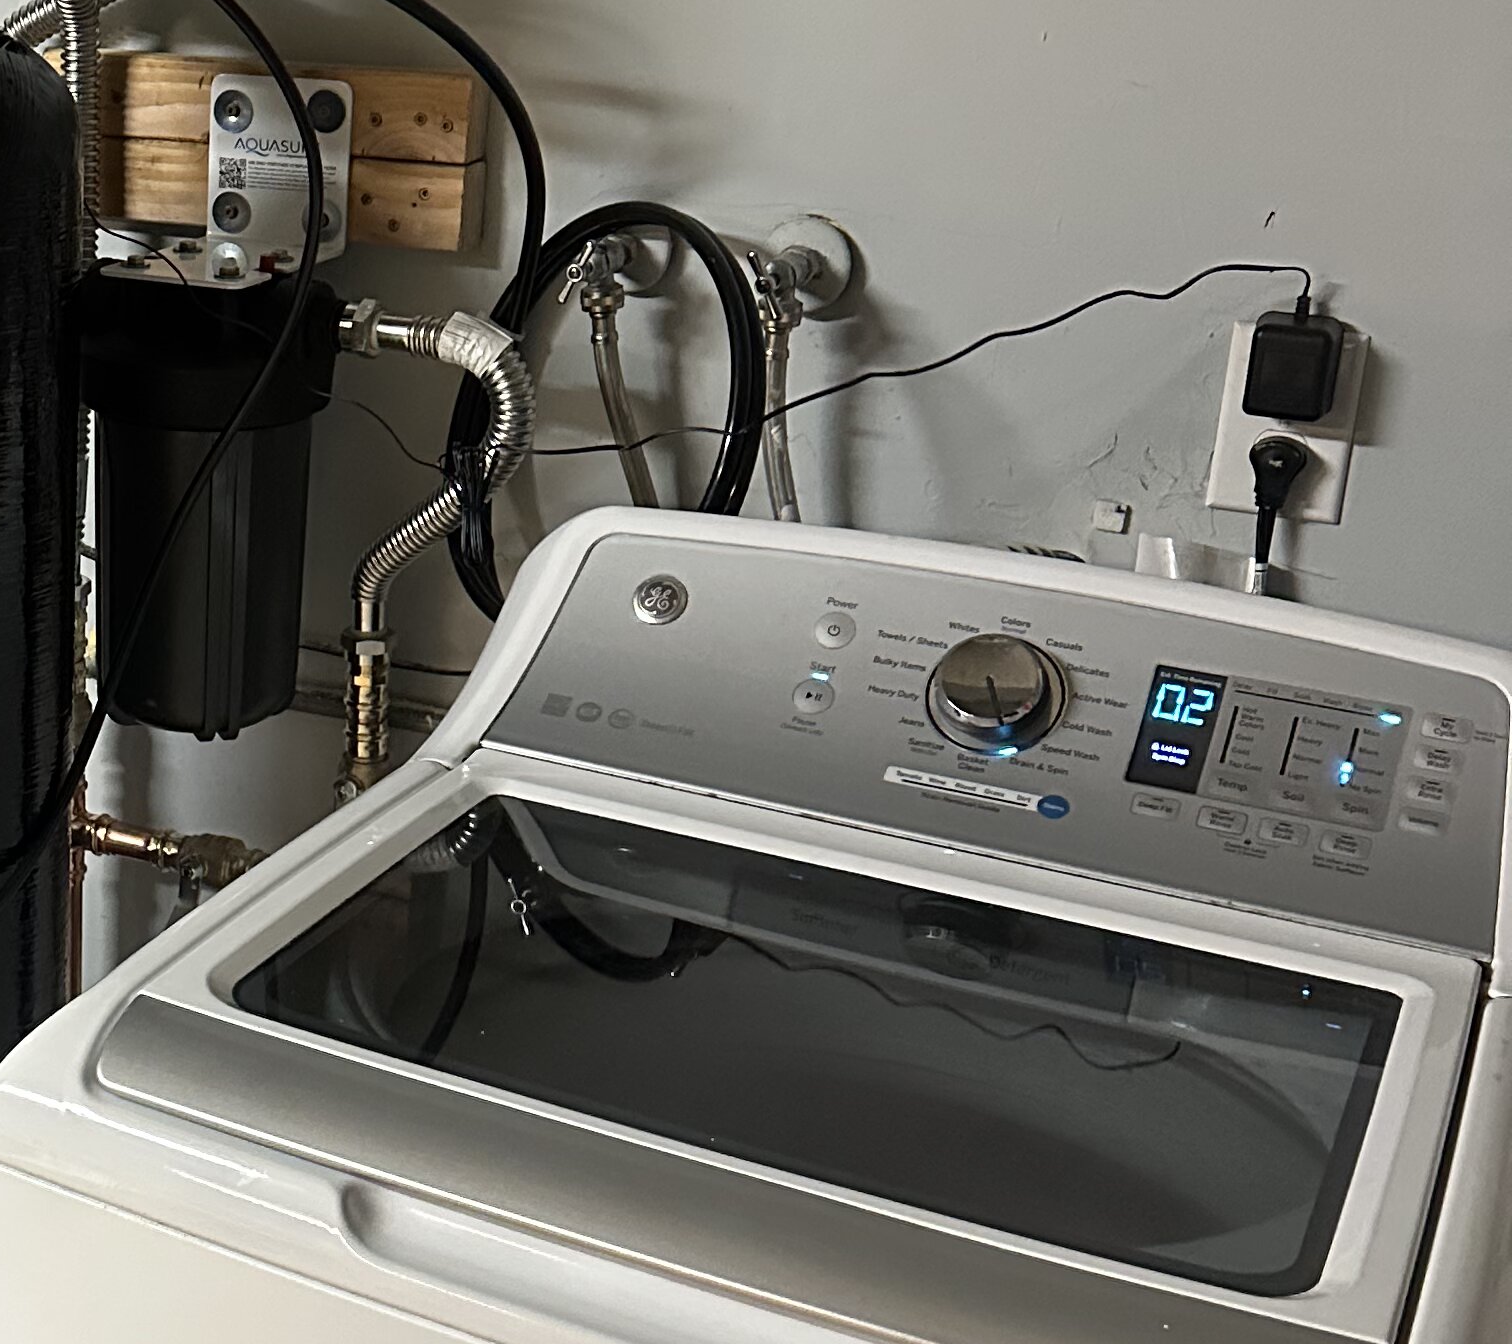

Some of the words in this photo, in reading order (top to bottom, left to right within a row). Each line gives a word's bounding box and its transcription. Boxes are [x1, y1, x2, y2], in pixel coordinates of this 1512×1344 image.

[234, 137, 307, 156] AQUASU
[826, 596, 859, 610] Power
[948, 621, 980, 634] Whites
[1001, 616, 1031, 628] Colors
[877, 629, 907, 643] Towels
[917, 636, 949, 650] Sheets
[1046, 638, 1083, 652] Casuals
[809, 661, 837, 674] Start
[873, 656, 899, 669] Bulky
[901, 659, 927, 672] Items
[1066, 663, 1110, 678] Delicates
[867, 684, 897, 699] Heavy
[898, 689, 920, 702] Duty
[1073, 692, 1103, 705] Active
[1103, 696, 1129, 709] Wear
[1152, 683, 1214, 726] 02
[898, 716, 925, 728] Jeans
[1062, 720, 1084, 732] Cold
[1085, 725, 1113, 738] Wash
[957, 753, 989, 766] Basket
[1040, 743, 1072, 758] Speed
[1073, 749, 1100, 762] Wash
[958, 762, 985, 774] Clean
[1009, 756, 1036, 769] Drain
[1037, 763, 1044, 771] &
[1047, 764, 1069, 777] Spin
[1217, 777, 1248, 792] Temp
[1282, 790, 1305, 803] Soil
[1342, 801, 1369, 816] Spin
